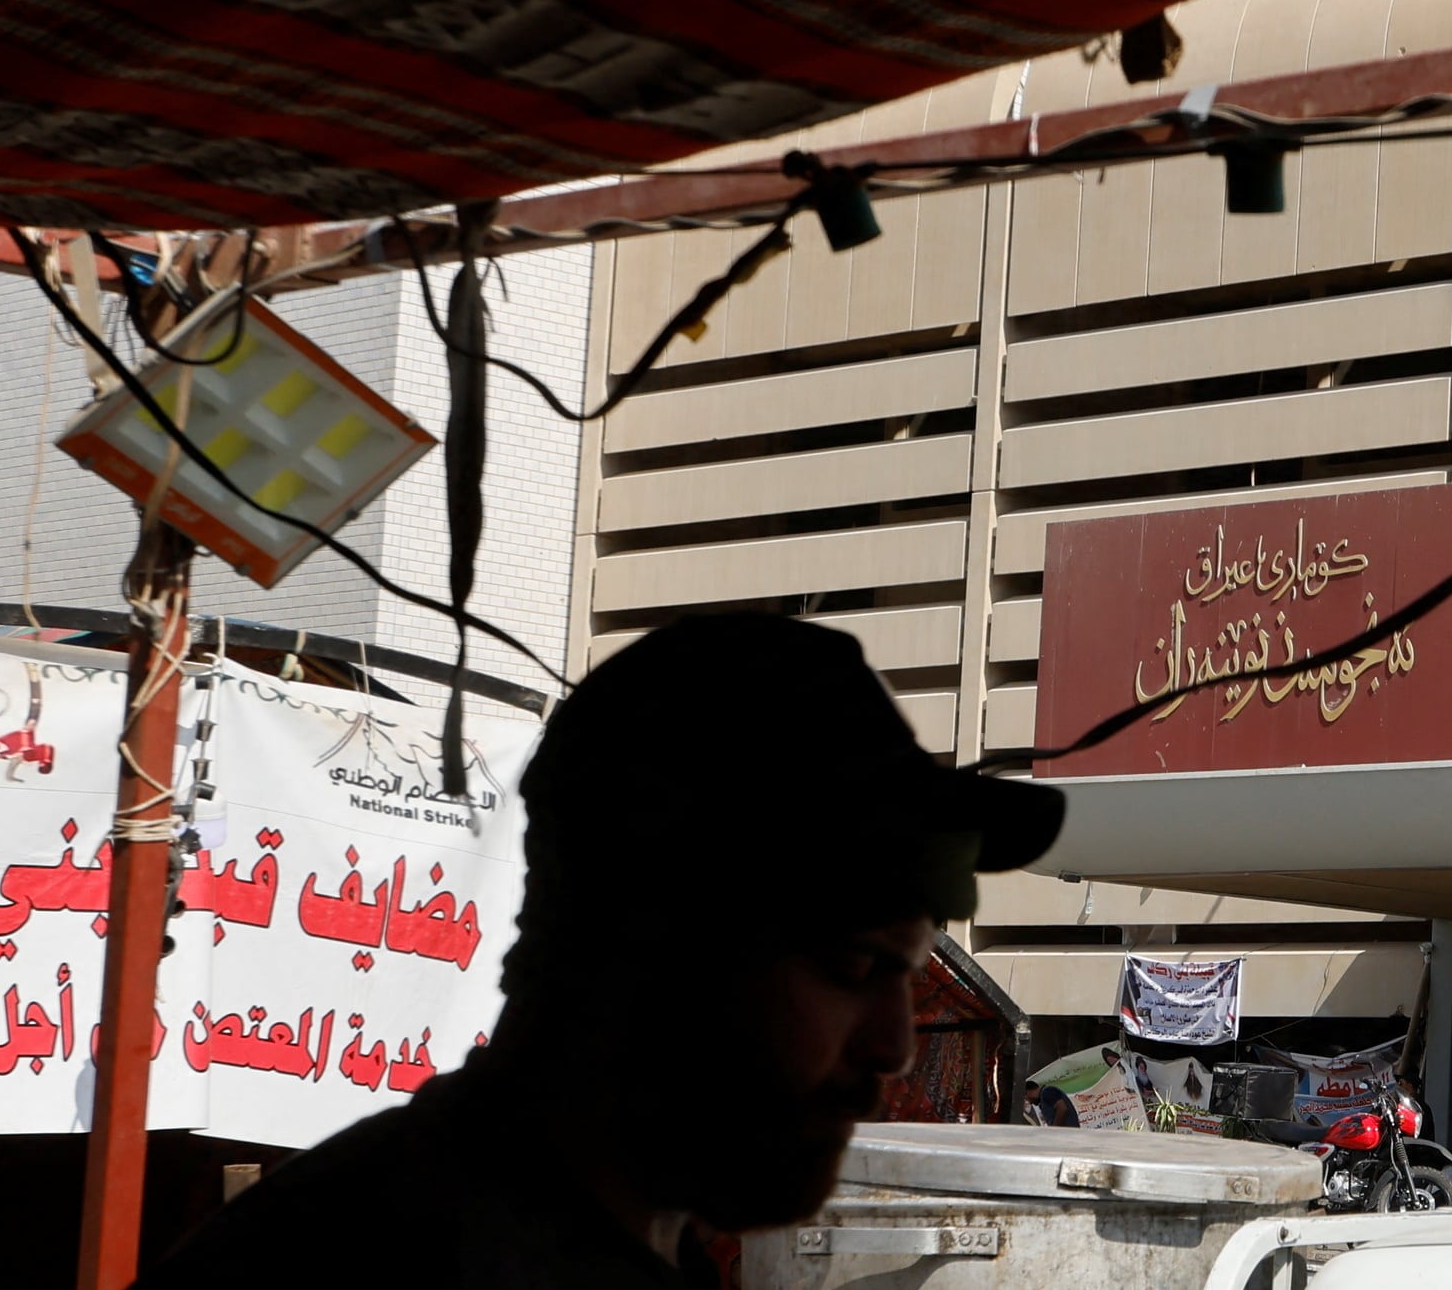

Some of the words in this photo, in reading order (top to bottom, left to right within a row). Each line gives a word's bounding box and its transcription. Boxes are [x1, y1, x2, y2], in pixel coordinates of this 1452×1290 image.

[328, 766, 403, 796] الوطني
[349, 793, 419, 821] National
[298, 844, 483, 973] مضايف
